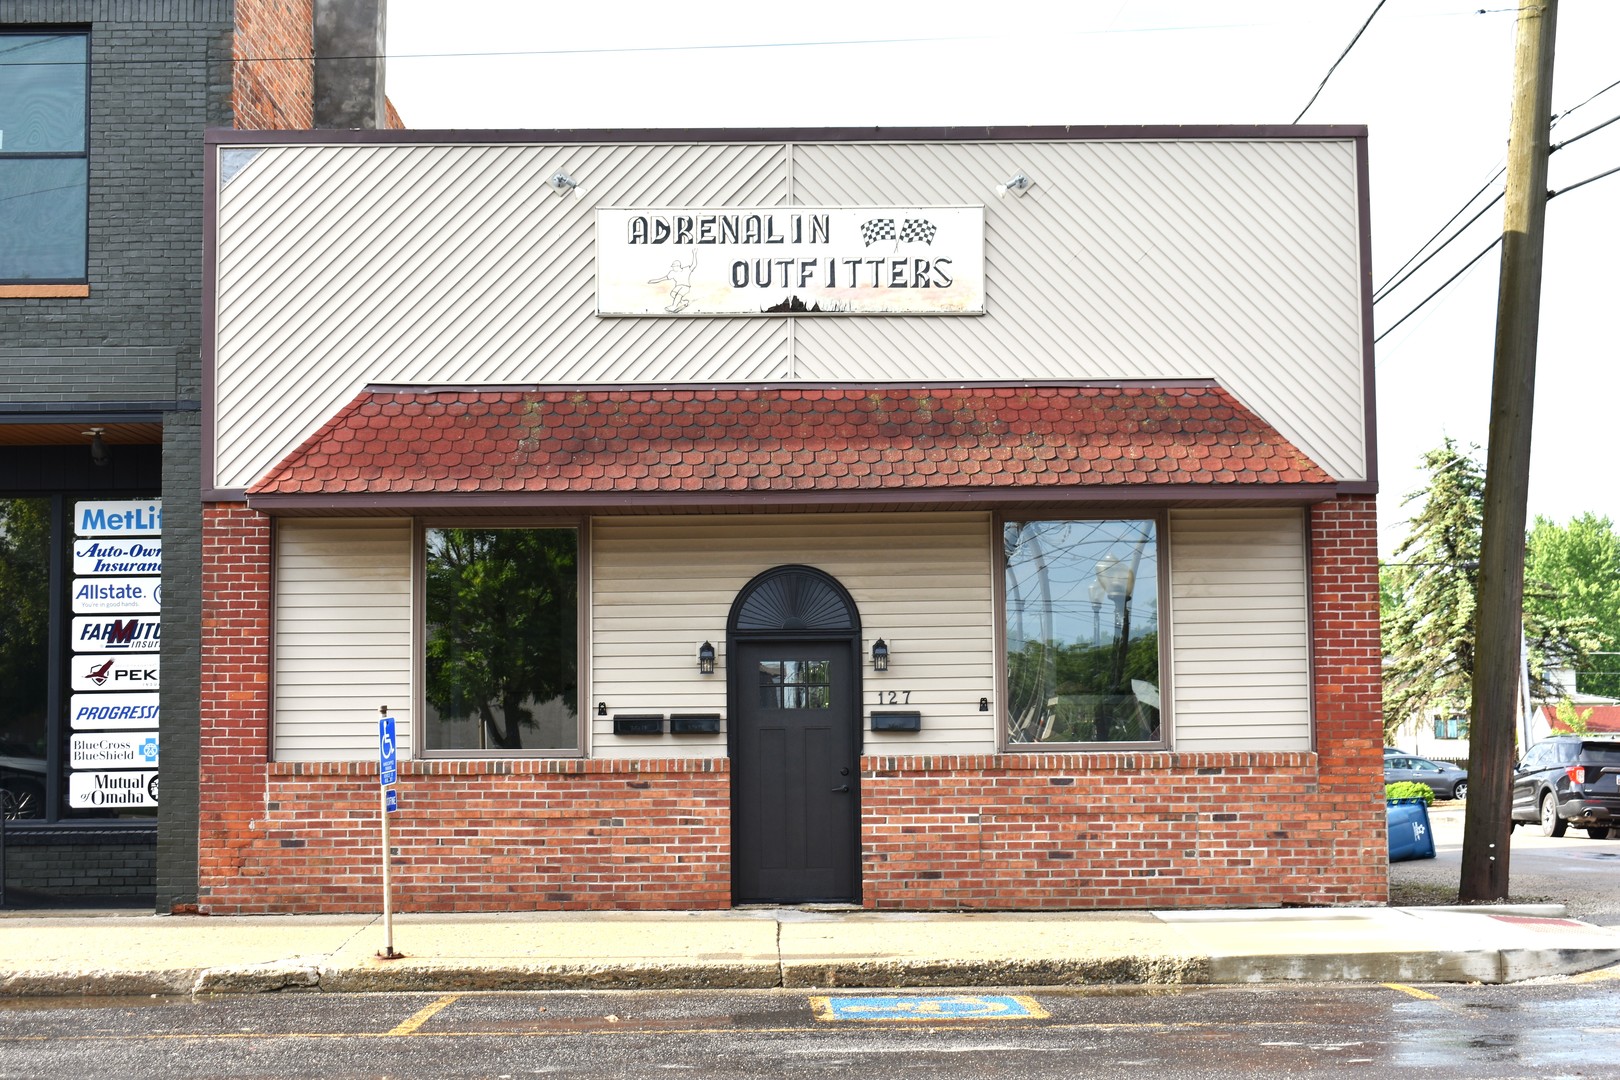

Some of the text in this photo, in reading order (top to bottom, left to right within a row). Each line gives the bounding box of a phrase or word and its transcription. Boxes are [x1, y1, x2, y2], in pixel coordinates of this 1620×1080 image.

[627, 214, 829, 245] ADRENALIN
[729, 256, 953, 289] OUTFITTERS
[131, 640, 160, 649] insur
[115, 669, 157, 681] PEK
[878, 690, 911, 705] 127
[74, 740, 131, 750] BlueCross
[74, 751, 134, 760] BlueShield
[95, 774, 144, 789] Mutual
[80, 789, 144, 806] of Omaha
